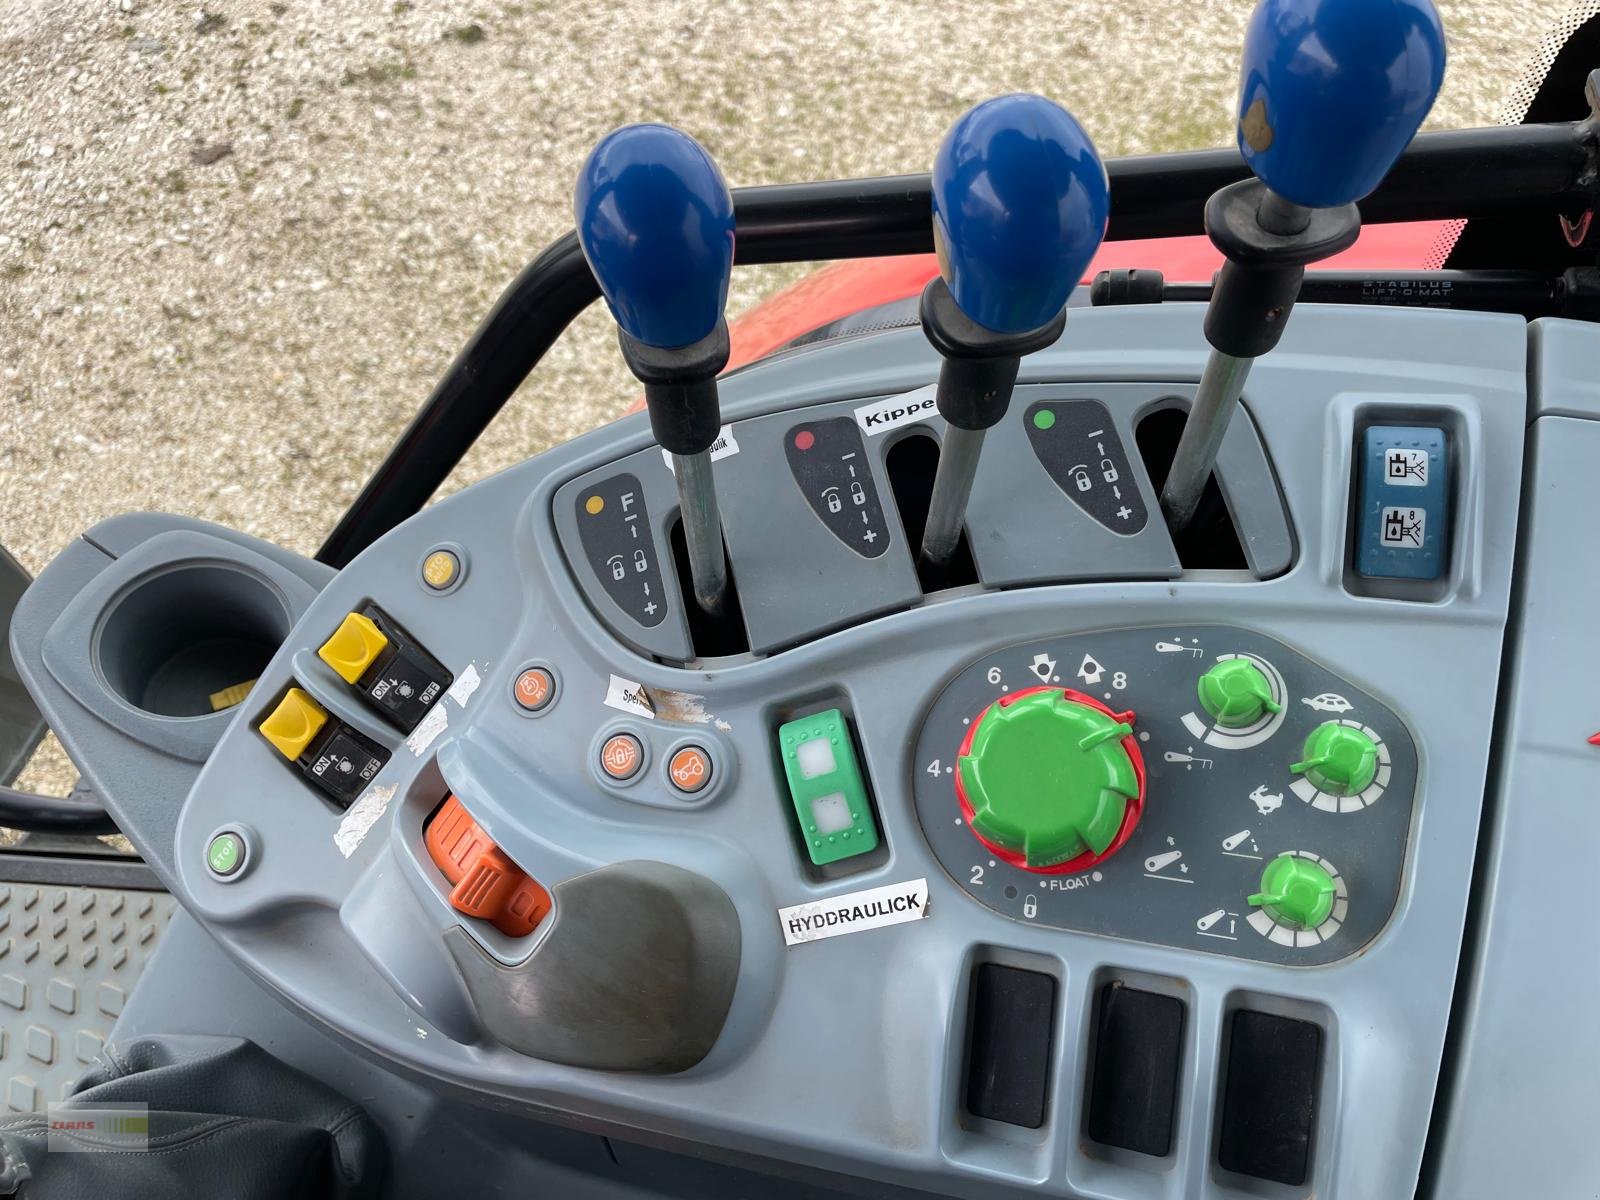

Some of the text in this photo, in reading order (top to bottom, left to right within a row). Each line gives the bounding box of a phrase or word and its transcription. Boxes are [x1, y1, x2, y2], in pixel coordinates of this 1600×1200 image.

[1412, 453, 1417, 461] 7
[621, 492, 634, 512] F
[1409, 510, 1415, 520] 8
[987, 667, 1002, 684] 6
[1112, 672, 1127, 689] 8
[373, 681, 390, 698] ON
[420, 683, 439, 703] OFF
[314, 758, 330, 774] ON
[361, 759, 380, 779] OFF
[927, 760, 941, 777] 4
[213, 840, 233, 867] STOP
[970, 865, 984, 885] 2
[1050, 875, 1090, 891] FLOAT
[789, 893, 920, 934] HYDDRAULICK
